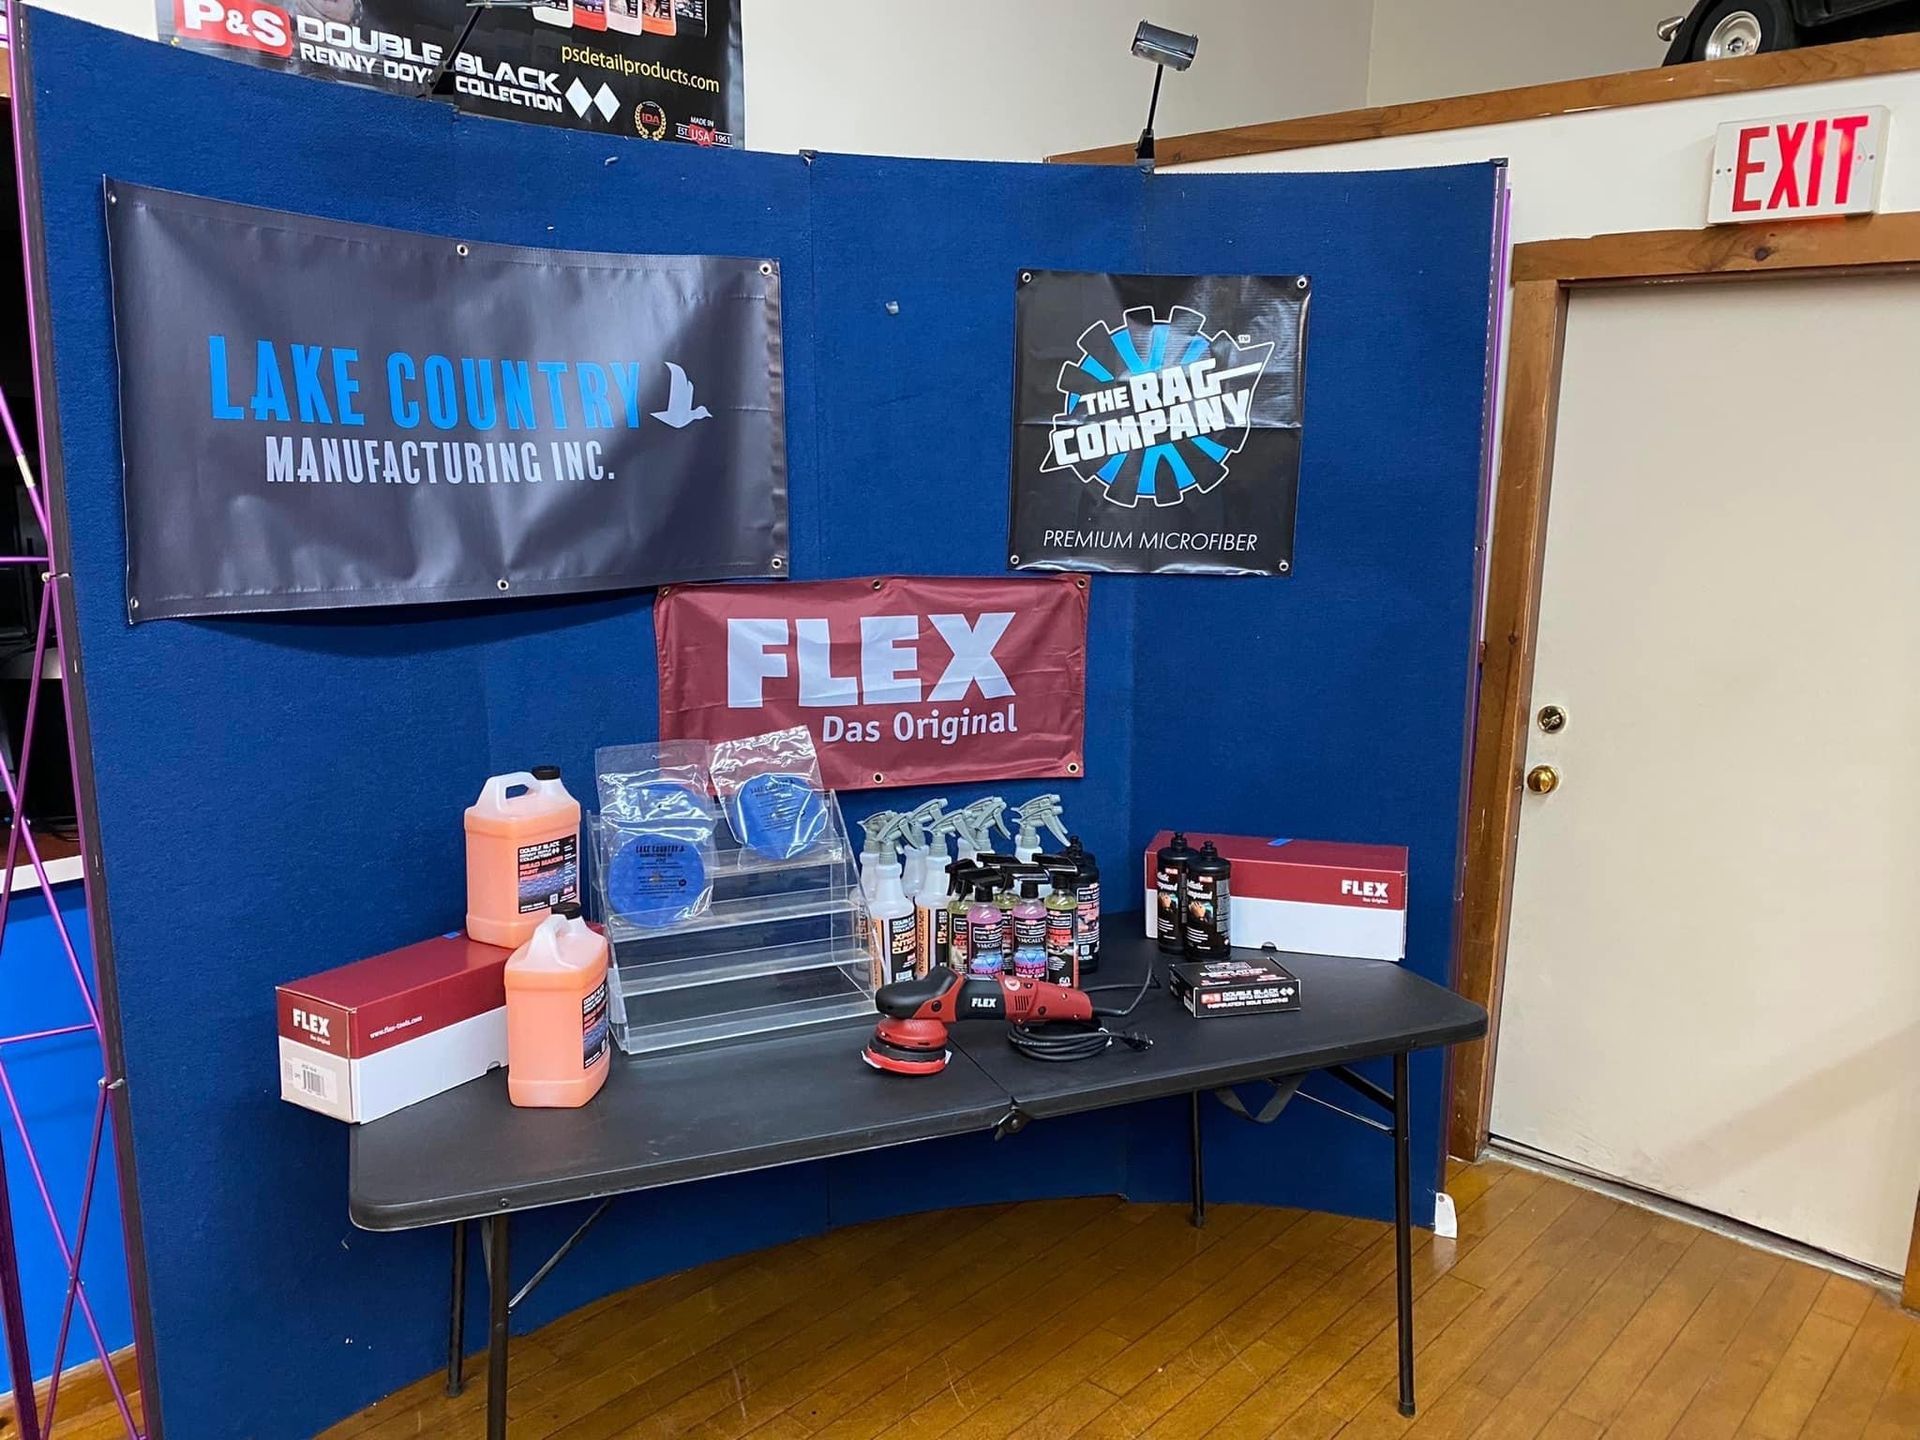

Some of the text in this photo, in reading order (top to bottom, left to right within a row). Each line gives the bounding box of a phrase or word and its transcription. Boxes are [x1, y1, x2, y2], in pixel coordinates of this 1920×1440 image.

[184, 0, 287, 48] P&S
[296, 14, 562, 95] DOUBLE BLACK
[300, 43, 376, 75] RENNY
[454, 75, 563, 114] COLLECTION
[561, 44, 721, 94] psdetailproducts.com
[641, 112, 660, 126] IDA
[690, 115, 715, 128] MADE IN
[690, 128, 710, 143] USA
[715, 134, 731, 144] 1961
[1731, 115, 1869, 213] EXIT
[208, 335, 641, 430] LAKE COUNTRY
[1078, 357, 1262, 416] THE RAG
[1051, 388, 1250, 466] COMPANY
[265, 436, 615, 484] MANUFACTURING INC.
[1043, 530, 1258, 551] PREMIUM MICROFIBER
[727, 612, 1017, 709] FLEX
[822, 704, 1018, 746] Das Original
[1341, 879, 1389, 898] FLEX
[292, 1007, 330, 1038] FLEX
[971, 997, 997, 1008] FLEX
